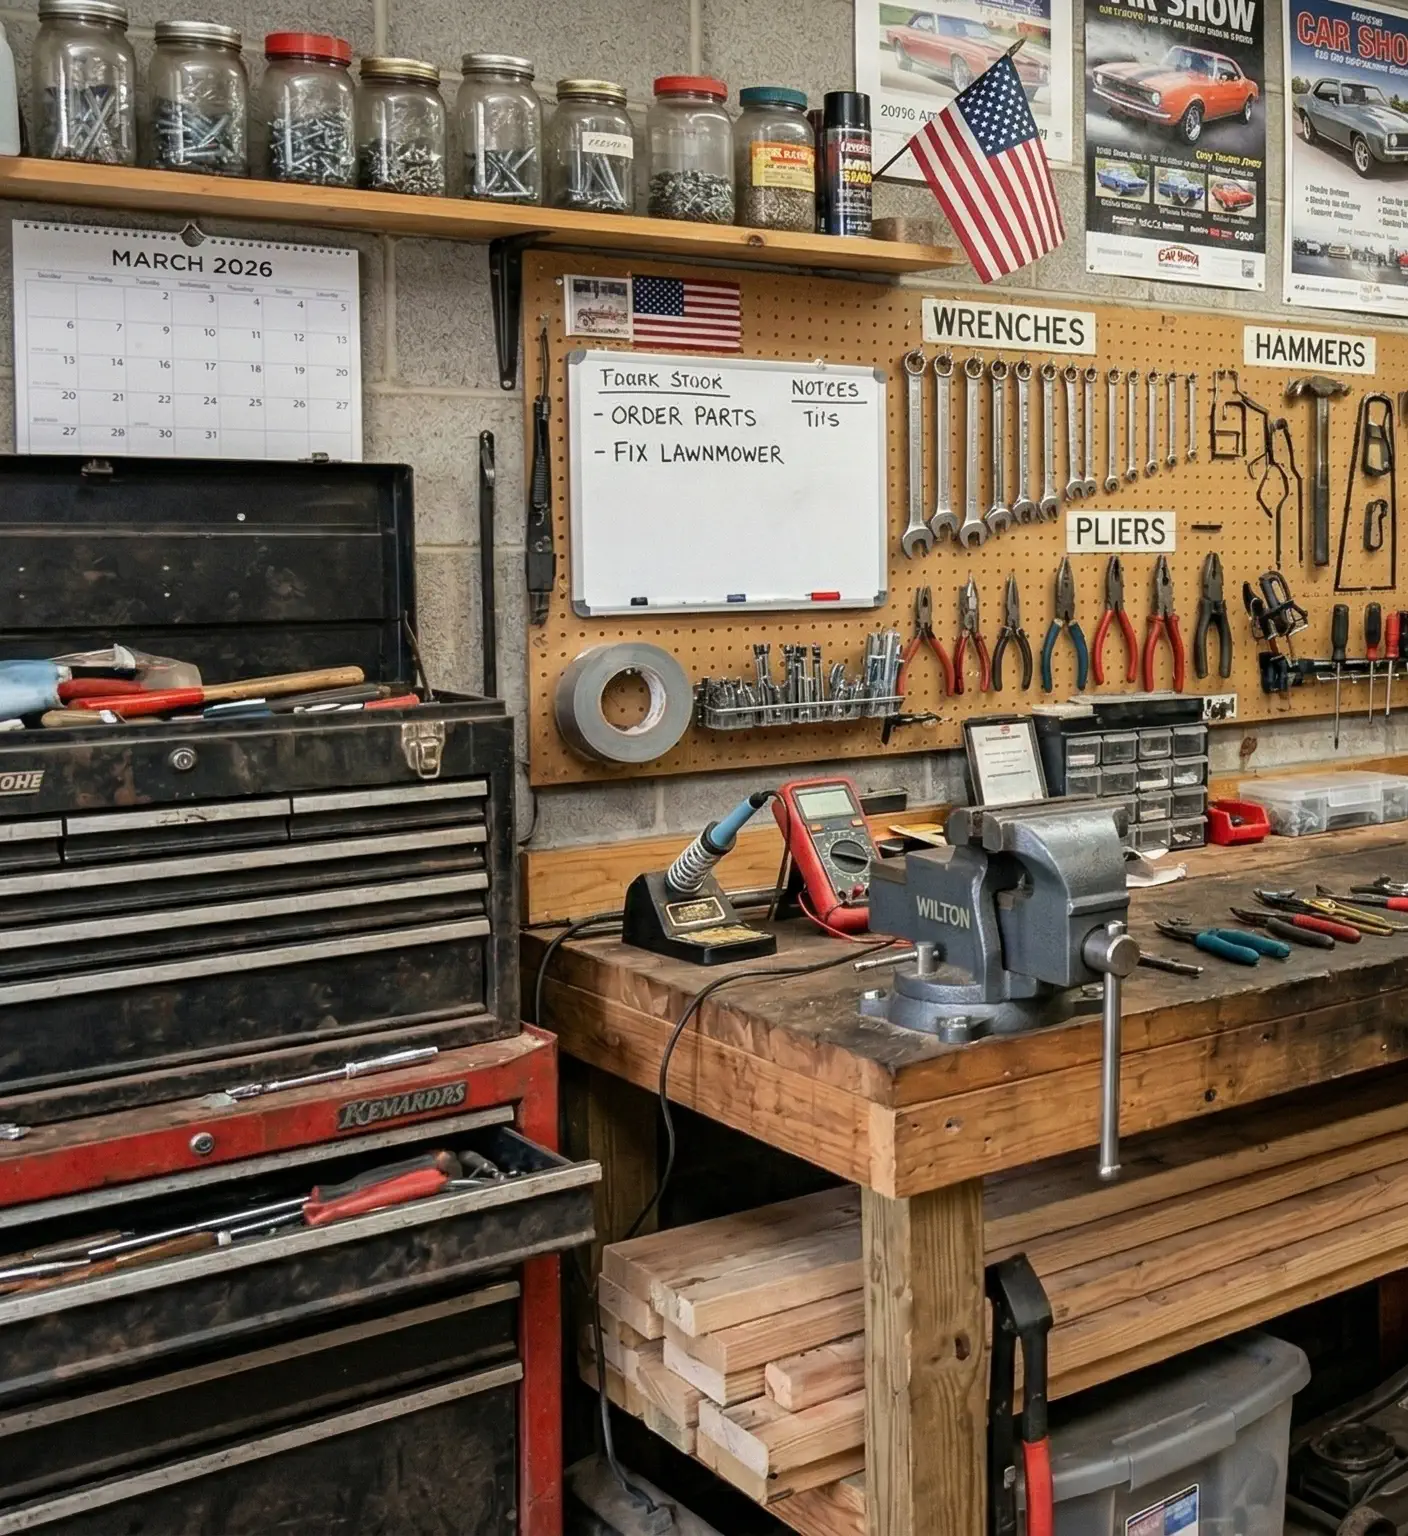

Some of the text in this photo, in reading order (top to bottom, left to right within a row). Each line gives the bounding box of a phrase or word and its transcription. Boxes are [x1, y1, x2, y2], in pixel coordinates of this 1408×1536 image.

[1167, 0, 1256, 33] SHOW
[1297, 11, 1351, 53] CAR
[113, 250, 273, 278] MARCH 2026
[204, 328, 216, 337] 10
[251, 330, 261, 339] 11
[293, 333, 305, 342] 12
[337, 335, 348, 344] 13
[933, 306, 1086, 346] WRENCHES
[1256, 333, 1366, 367] HAMMERS
[63, 355, 349, 377] 13 14 16 17 18 19 20
[61, 391, 349, 410] 20 21 22 24 25 26 27
[612, 405, 683, 426] ORDER
[695, 405, 757, 427] PARTS
[62, 427, 77, 436] 27
[159, 429, 173, 438] 30
[205, 430, 218, 440] 31
[614, 441, 648, 462] FIX
[661, 443, 785, 465] LAWNMOWER
[1076, 517, 1166, 545] PLIERS
[916, 895, 970, 930] WILTON
